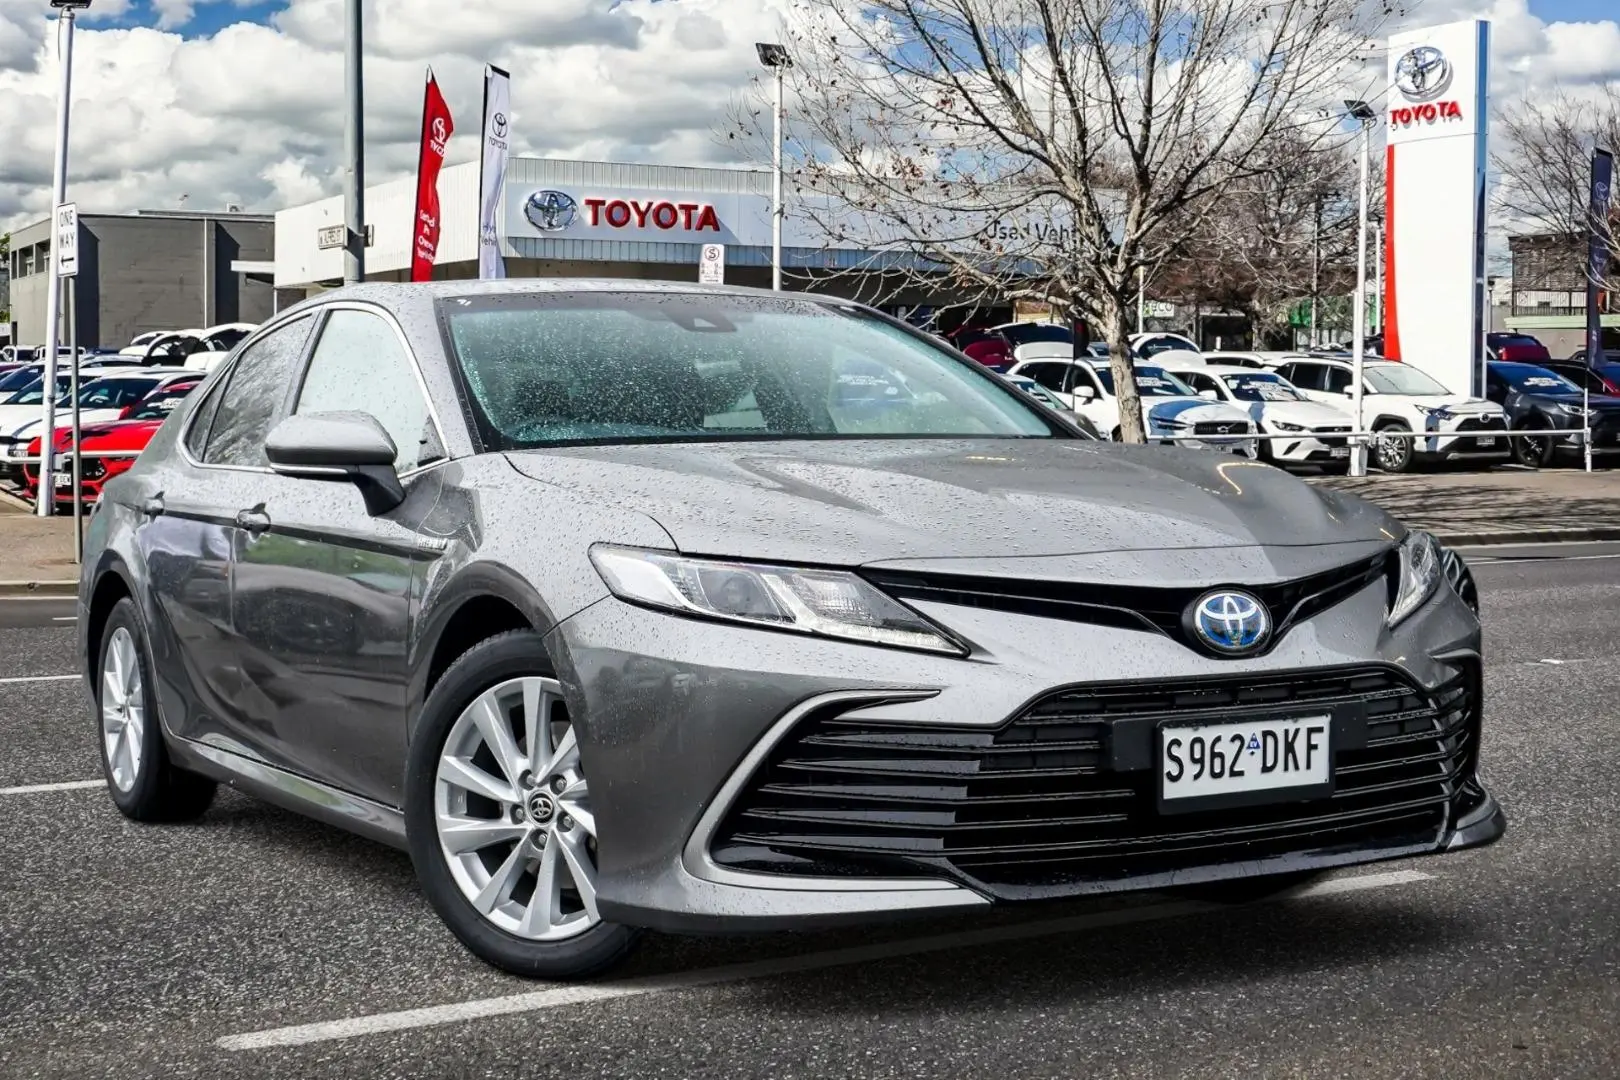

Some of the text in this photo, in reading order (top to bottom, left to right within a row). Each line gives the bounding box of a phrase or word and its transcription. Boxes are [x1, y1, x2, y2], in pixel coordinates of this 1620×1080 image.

[1389, 101, 1463, 125] TOYOTA
[60, 209, 74, 227] ONE
[584, 198, 721, 232] TOYOTA
[59, 232, 75, 249] WAY
[1165, 726, 1324, 783] S962 DKF
